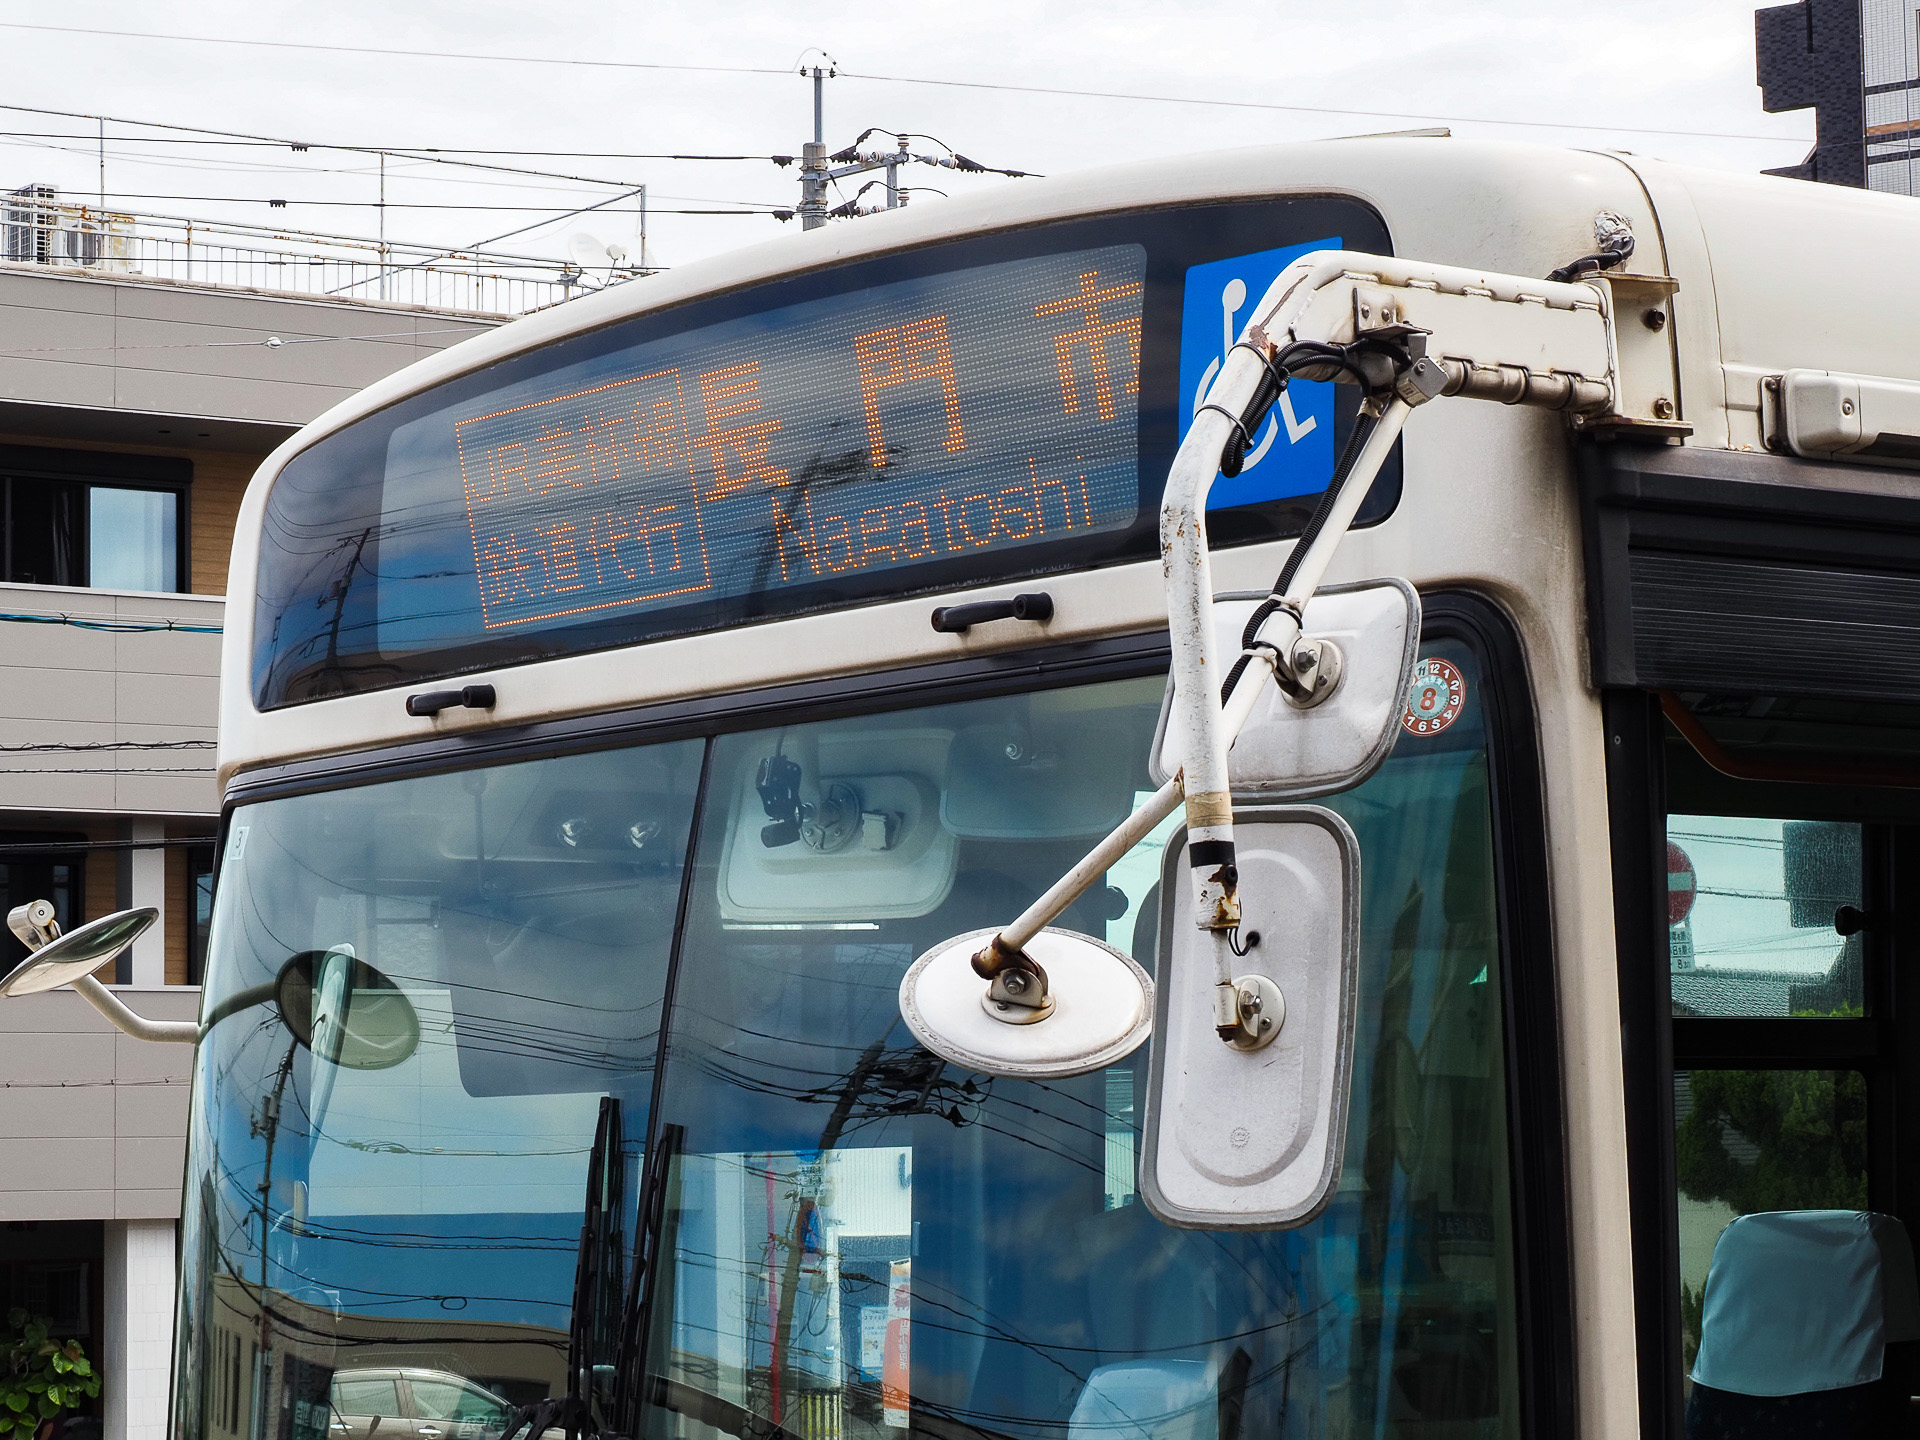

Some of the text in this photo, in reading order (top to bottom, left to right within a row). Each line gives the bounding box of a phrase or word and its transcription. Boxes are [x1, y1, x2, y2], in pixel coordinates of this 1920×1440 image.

[471, 396, 683, 501] JR美祢線
[771, 454, 1092, 582] Nagatoshi
[484, 505, 682, 605] 鉄道代行
[1418, 666, 1426, 675] 11
[1430, 664, 1440, 674] 12
[1443, 669, 1450, 679] 1
[1450, 680, 1459, 690] 2
[1420, 688, 1436, 710] 8
[1450, 695, 1459, 705] 3
[1443, 710, 1452, 719] 4
[1407, 716, 1416, 727] 7
[1418, 721, 1427, 732] 6
[1431, 719, 1441, 729] 5
